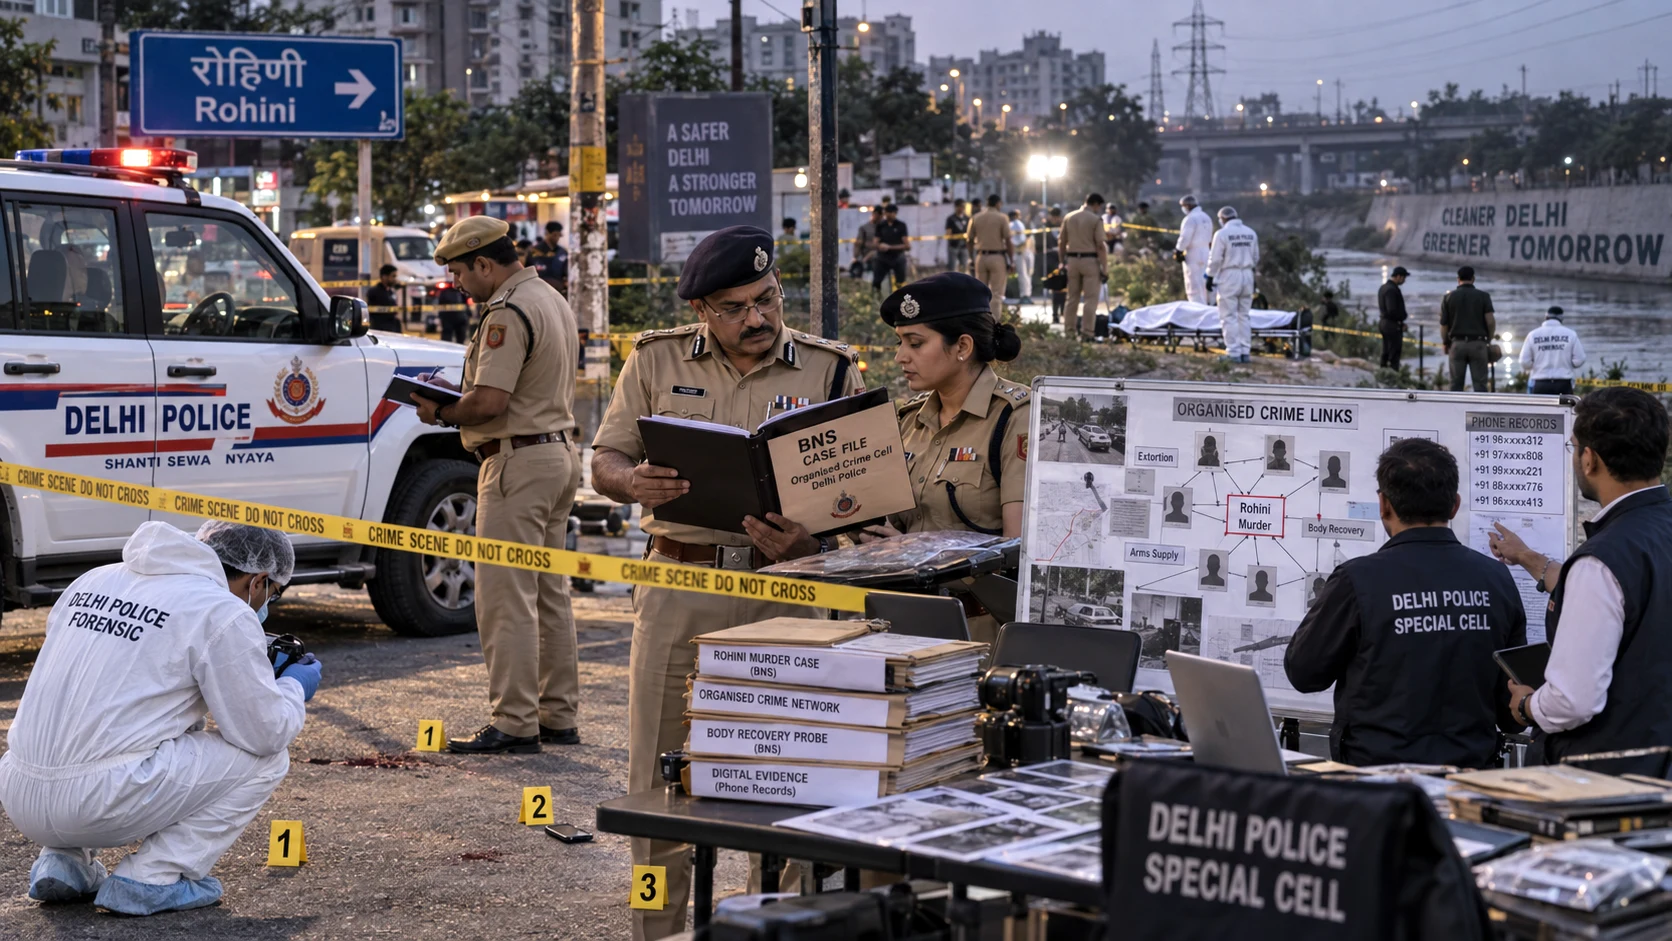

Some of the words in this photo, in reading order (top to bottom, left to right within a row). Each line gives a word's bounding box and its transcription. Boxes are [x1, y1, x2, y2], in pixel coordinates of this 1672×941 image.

[190, 46, 307, 91] रोहिणी
[195, 96, 296, 123] Rohini
[667, 124, 678, 142] A
[682, 122, 730, 142] SAFER
[668, 148, 710, 167] DELHI
[669, 175, 679, 192] A
[682, 172, 757, 191] STRONGER
[669, 195, 758, 216] TOMORROW
[1442, 206, 1496, 227] CLEANER
[1506, 202, 1568, 227] DELHI
[1423, 232, 1490, 257] GREENER
[1508, 234, 1664, 265] TOMORROW
[65, 404, 145, 435] DELHI
[162, 403, 251, 432] POLICE
[1177, 402, 1254, 419] ORGANISED
[1260, 405, 1304, 421] CRIME
[1310, 408, 1353, 424] LINKS
[1471, 416, 1506, 428] PHONE
[1508, 417, 1557, 430] RECORDS
[798, 429, 837, 453] BNS
[1475, 434, 1489, 444] +91
[104, 456, 160, 470] SHANTI
[167, 454, 211, 467] SEWA
[225, 452, 275, 464] NYAYA
[802, 447, 837, 467] CASE
[842, 437, 868, 454] FILE
[1138, 452, 1173, 462] Extortion
[1475, 450, 1489, 459] +91
[790, 462, 840, 485] Organised
[842, 455, 871, 469] Crime
[873, 445, 892, 459] Cell
[1475, 466, 1489, 475] +91
[17, 469, 45, 487] CRIME
[47, 474, 76, 493] SCENE
[80, 479, 93, 496] DO
[95, 482, 115, 499] NOT
[117, 485, 149, 506] CROSS
[811, 475, 836, 490] Delhi
[838, 467, 867, 482] Police
[1475, 480, 1489, 490] +91
[1240, 502, 1271, 515] Rohini
[1475, 496, 1489, 505] +91
[174, 495, 204, 515] CRIME
[207, 500, 239, 520] SCENE
[245, 506, 259, 523] DO
[263, 510, 284, 527] NOT
[287, 513, 324, 534] CROSS
[1238, 519, 1272, 531] Murder
[1308, 523, 1327, 535] Body
[1329, 524, 1365, 536] Recovery
[368, 526, 404, 547] CRIME
[409, 532, 449, 554] SCENE
[455, 539, 473, 557] DO
[477, 542, 503, 561] NOT
[506, 547, 551, 569] CROSS
[1129, 548, 1150, 558] Arms
[1152, 550, 1179, 561] Supply
[621, 563, 661, 583] CRIME
[665, 568, 708, 589] SCENE
[714, 574, 734, 592] DO
[739, 577, 767, 596] NOT
[770, 581, 816, 602] CROSS
[68, 592, 110, 611] DELHI
[108, 598, 170, 629] POLICE
[1392, 592, 1438, 611] DELHI
[1443, 591, 1490, 607] POLICE
[68, 611, 144, 642] FORENSIC
[1395, 615, 1455, 635] SPECIAL
[1459, 615, 1491, 630] CELL
[713, 650, 747, 662] ROHINI
[750, 652, 791, 666] MURDER
[794, 657, 819, 669] CASE
[750, 666, 777, 678] (BNS)
[699, 688, 754, 704] ORGANISED
[757, 694, 788, 707] CRIME
[791, 698, 840, 713] NETWORK
[424, 726, 434, 746] 1
[707, 728, 735, 740] BODY
[737, 729, 791, 742] RECOVERY
[794, 732, 828, 744] PROBE
[754, 744, 781, 756] (BNS)
[712, 768, 752, 780] DIGITAL
[755, 770, 808, 784] EVIDENCE
[715, 782, 749, 794] (Phone
[752, 784, 796, 798] Records)
[532, 795, 547, 818] 2
[277, 829, 291, 858] 1
[1148, 801, 1237, 851] DELHI
[1244, 814, 1349, 870] POLICE
[640, 873, 657, 901] 3
[1143, 852, 1265, 909] SPECIAL
[1274, 871, 1346, 924] CELL
